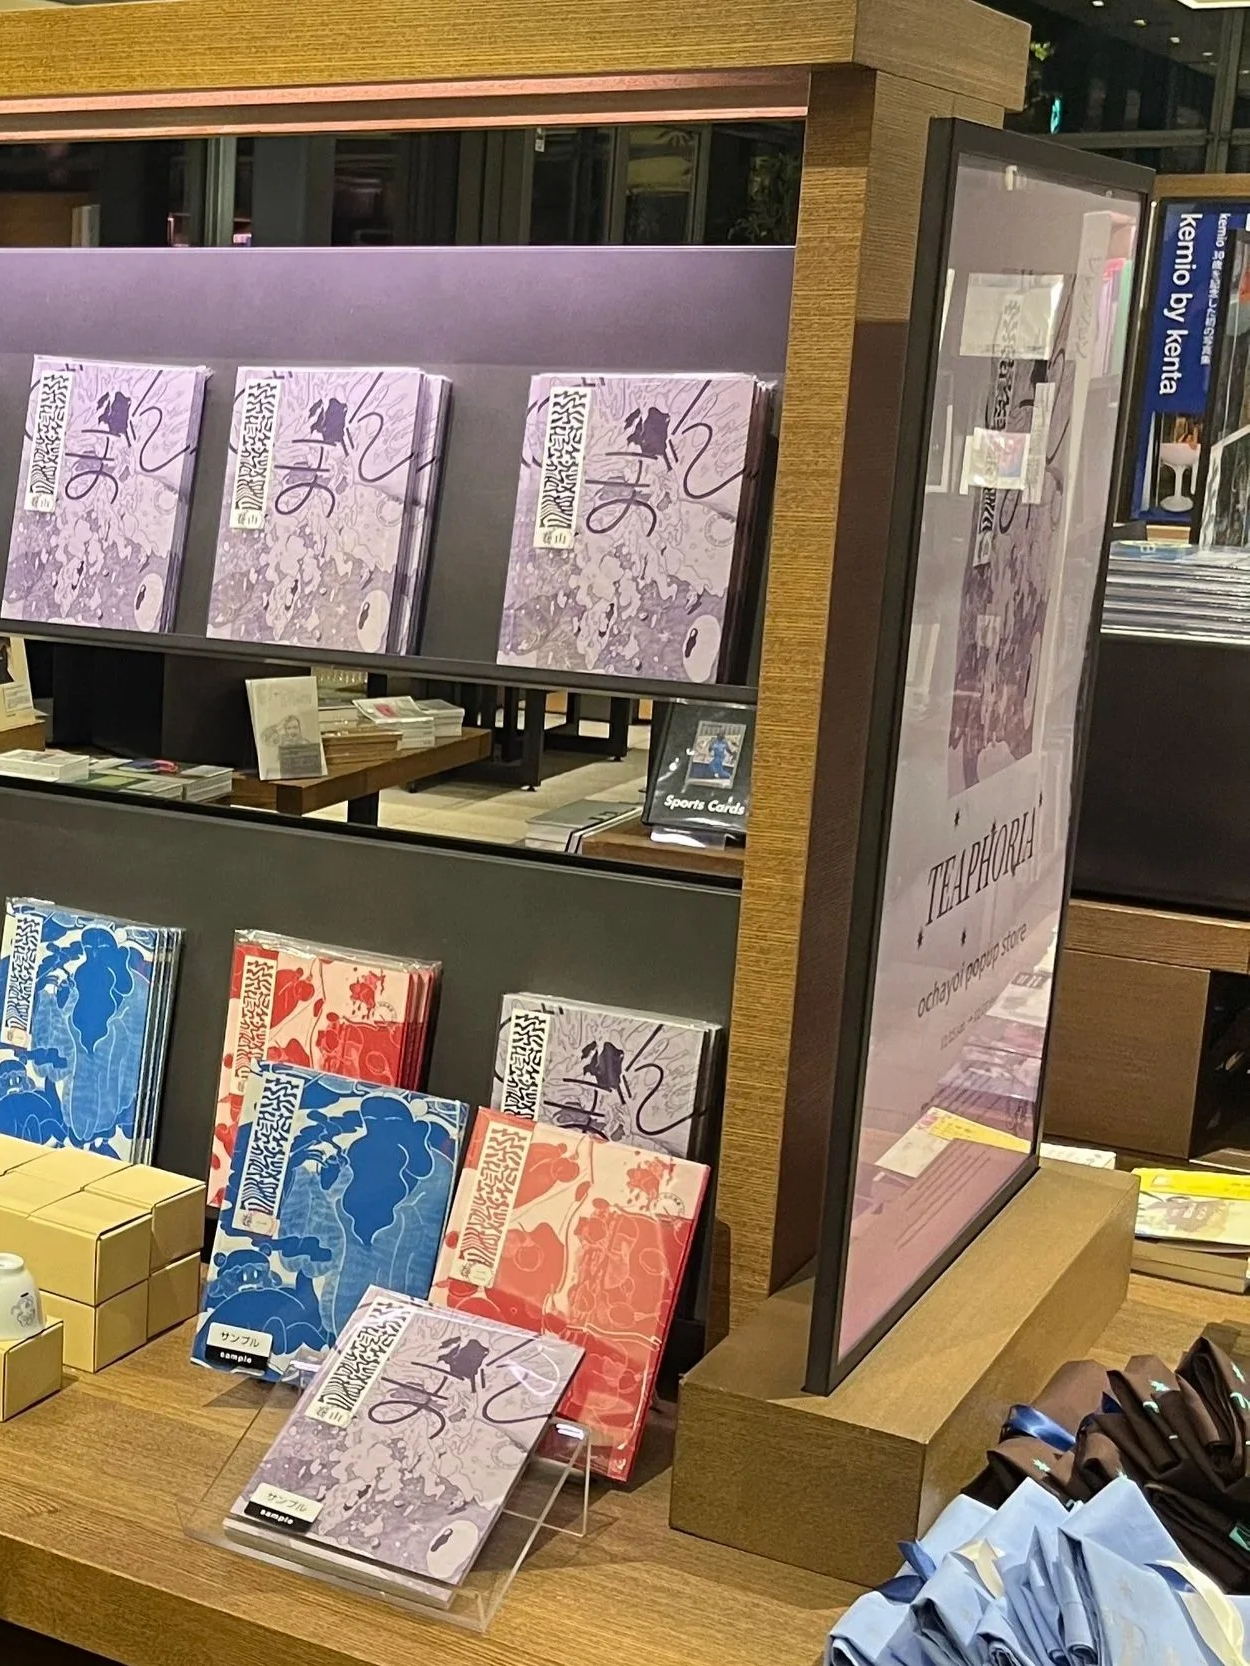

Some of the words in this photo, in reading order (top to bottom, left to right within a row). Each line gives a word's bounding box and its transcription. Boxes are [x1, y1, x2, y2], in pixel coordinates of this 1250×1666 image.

[1215, 212, 1231, 248] kemio
[1172, 213, 1204, 287] kemio
[1163, 293, 1193, 323] by
[1159, 329, 1189, 395] kenta
[664, 795, 705, 810] Sports
[707, 798, 745, 816] Cards
[925, 807, 1037, 926] TEAPHORIA
[918, 970, 965, 1018] ochayoi
[1000, 922, 1028, 957] store
[221, 1331, 259, 1348] サンプル
[219, 1351, 252, 1364] sample
[259, 1508, 294, 1526] sample
[267, 1492, 307, 1512] サンプル
